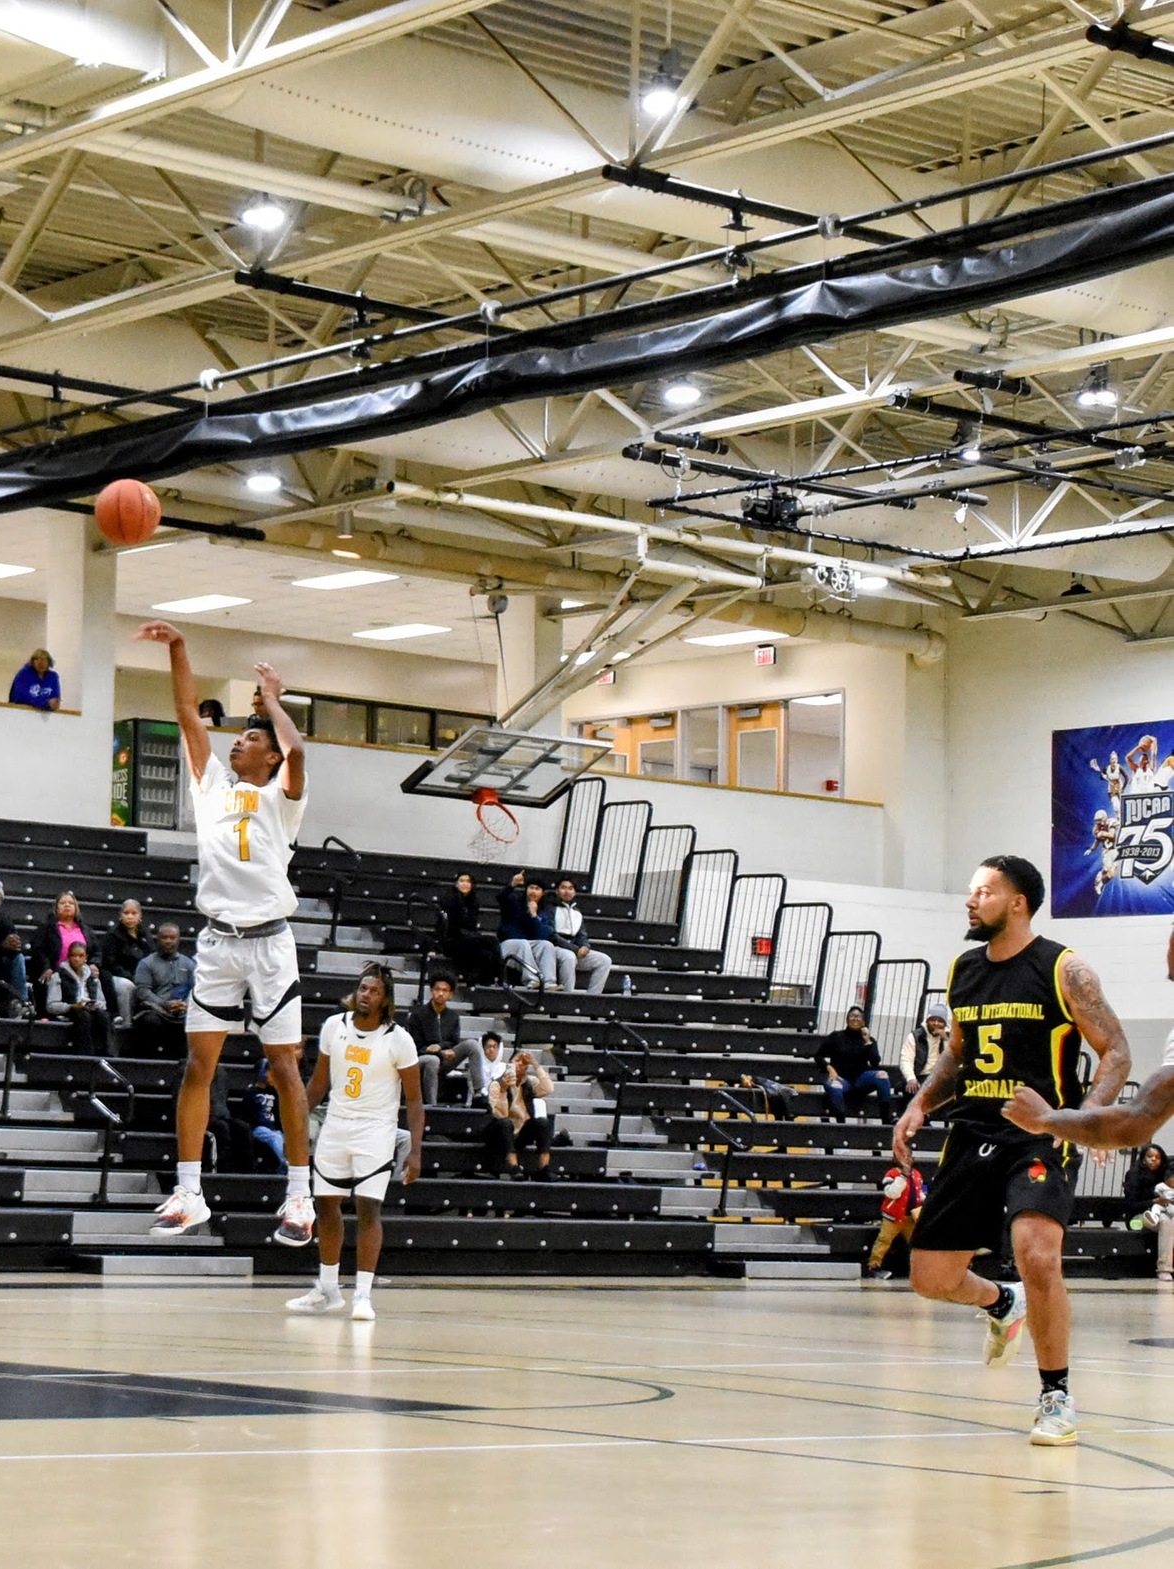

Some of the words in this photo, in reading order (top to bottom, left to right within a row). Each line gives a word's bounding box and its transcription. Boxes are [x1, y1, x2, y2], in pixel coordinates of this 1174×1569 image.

[113, 782, 128, 800] IDE
[1124, 796, 1171, 826] NJCAA
[233, 816, 250, 861] 1
[1117, 817, 1173, 878] 75
[1121, 847, 1161, 858] 1938-2013
[953, 1006, 979, 1022] NTRAL
[981, 1002, 1044, 1020] INTERNATIONAL
[974, 1023, 1004, 1074] 5
[345, 1067, 363, 1099] 3
